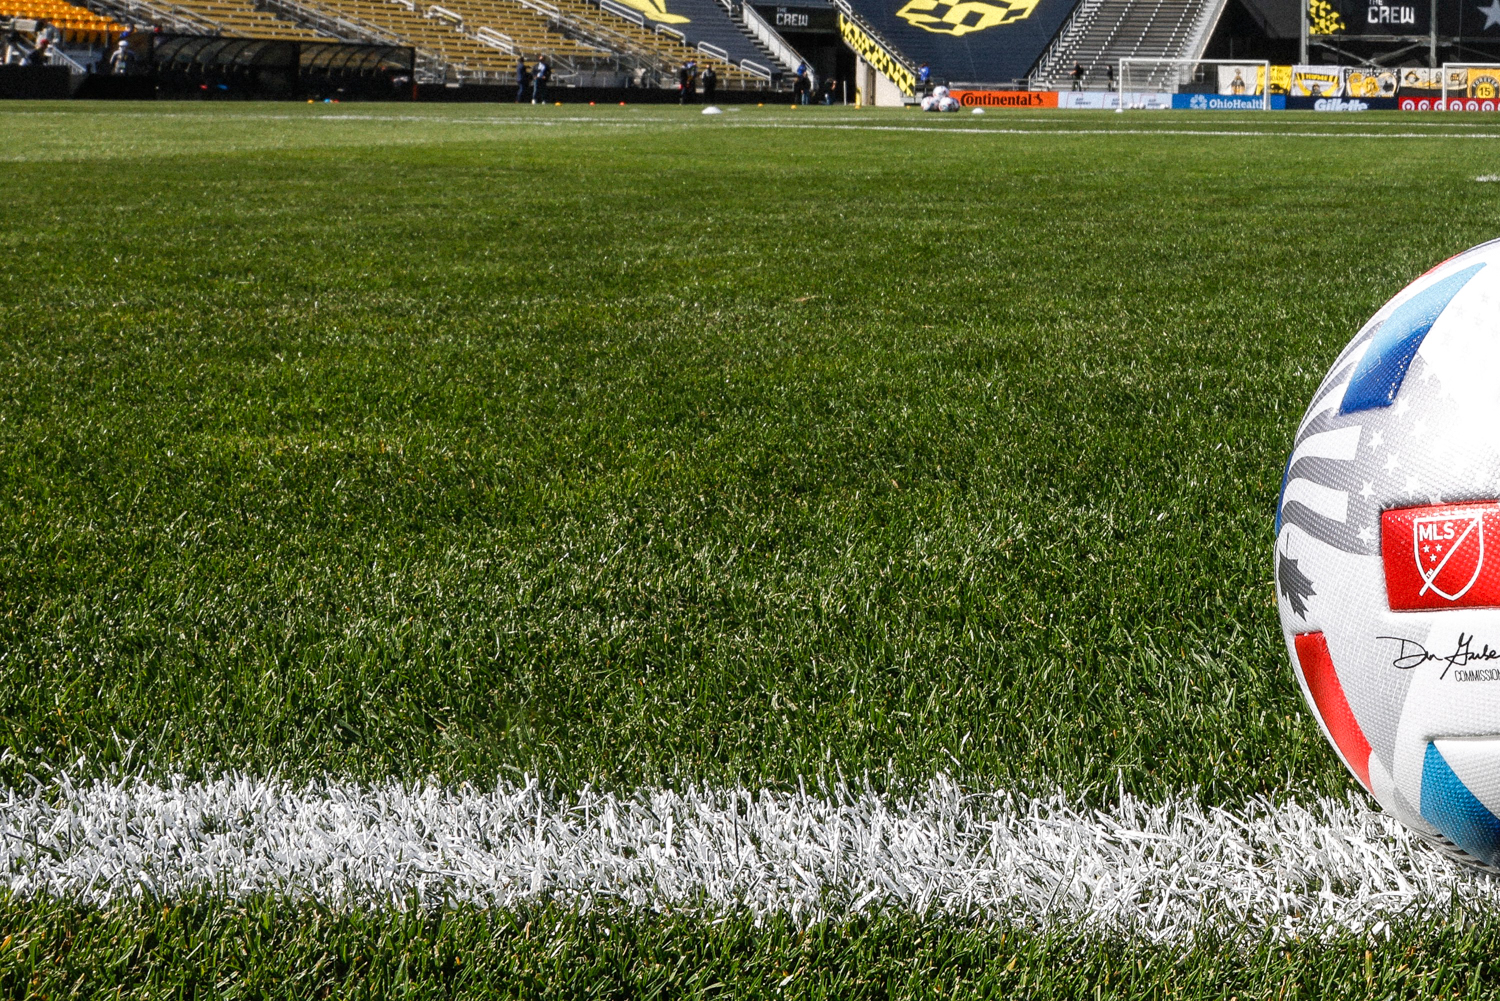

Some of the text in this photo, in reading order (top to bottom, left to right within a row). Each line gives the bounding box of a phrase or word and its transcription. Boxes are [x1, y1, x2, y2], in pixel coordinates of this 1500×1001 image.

[776, 13, 808, 27] CREW
[1367, 5, 1415, 24] CREW
[1479, 87, 1491, 96] 15
[961, 92, 1032, 107] Continental
[1314, 98, 1368, 111] Gillette
[1419, 522, 1455, 542] MLS
